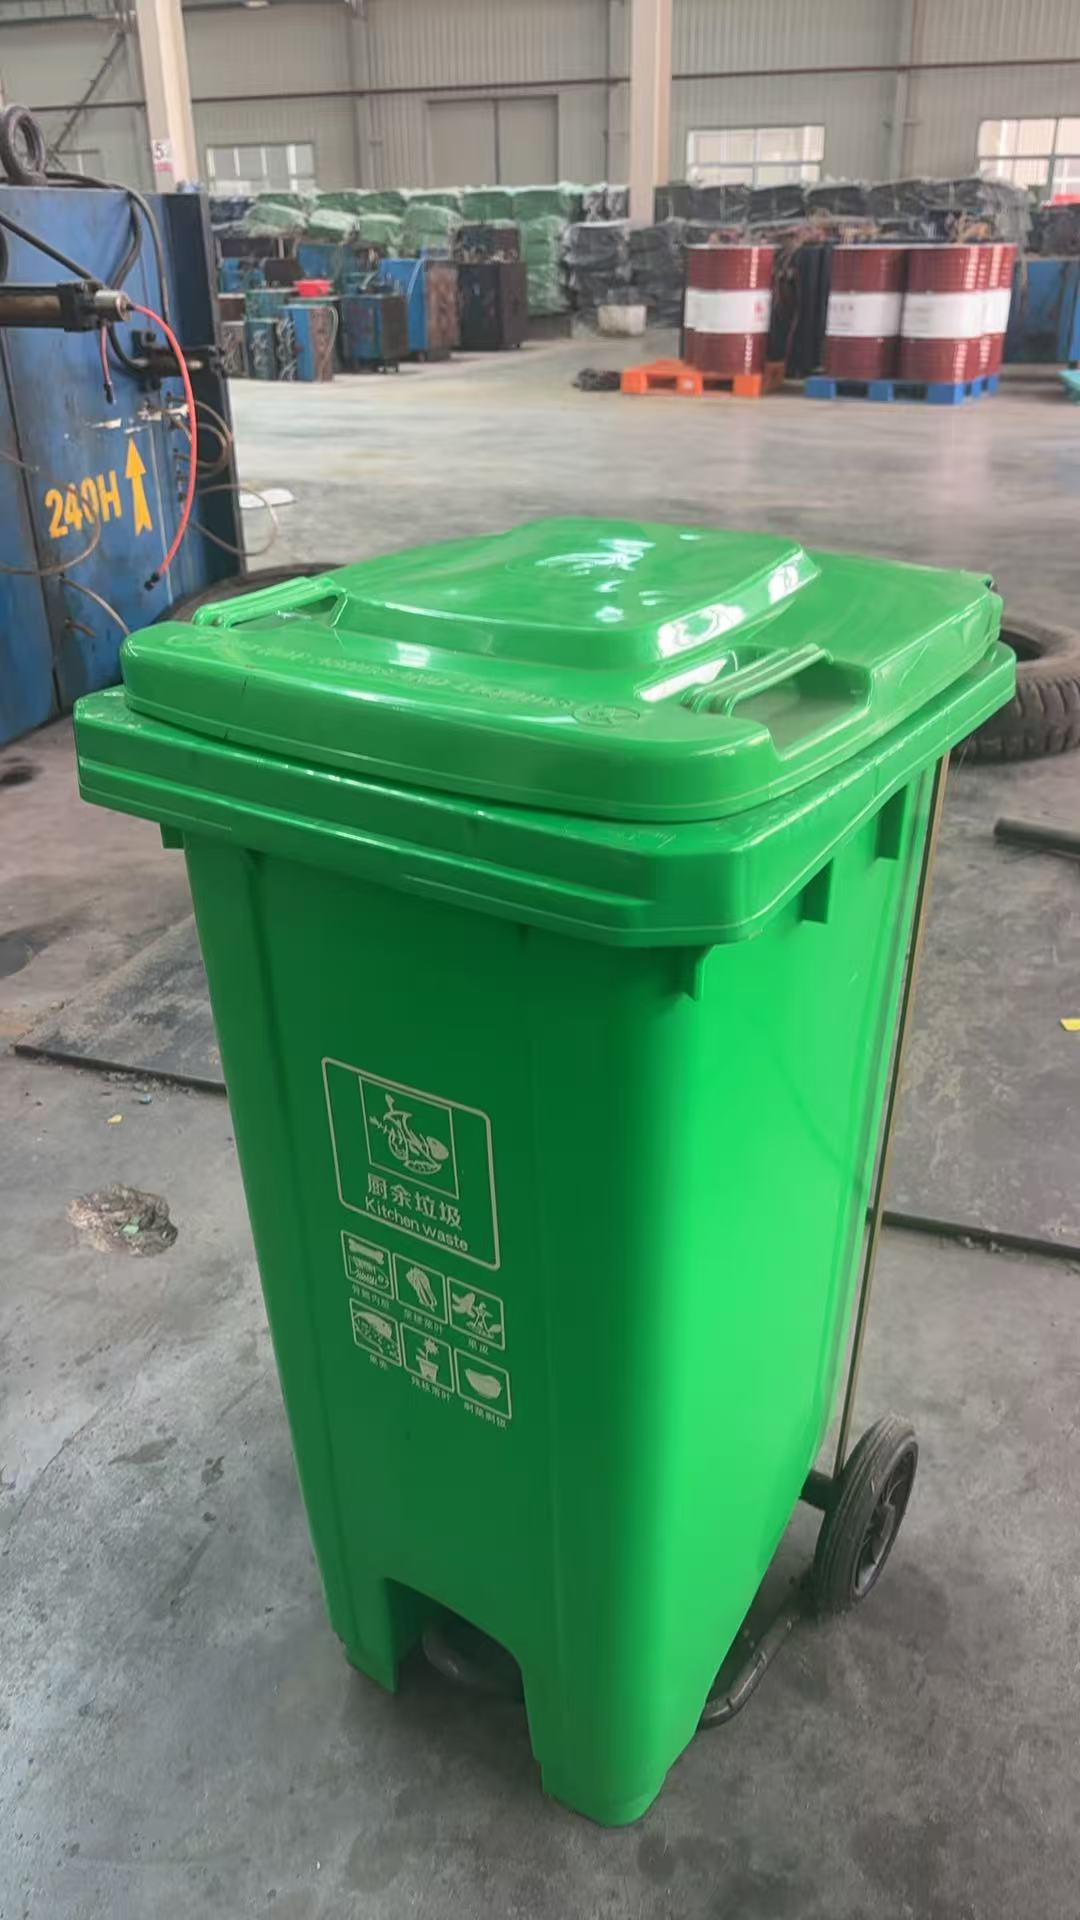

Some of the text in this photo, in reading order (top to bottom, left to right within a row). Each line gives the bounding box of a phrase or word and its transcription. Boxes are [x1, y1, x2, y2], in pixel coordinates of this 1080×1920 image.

[45, 469, 122, 539] 240H
[365, 1196, 468, 1252] Kitchen waste
[367, 1173, 463, 1230] 厨余垃圾
